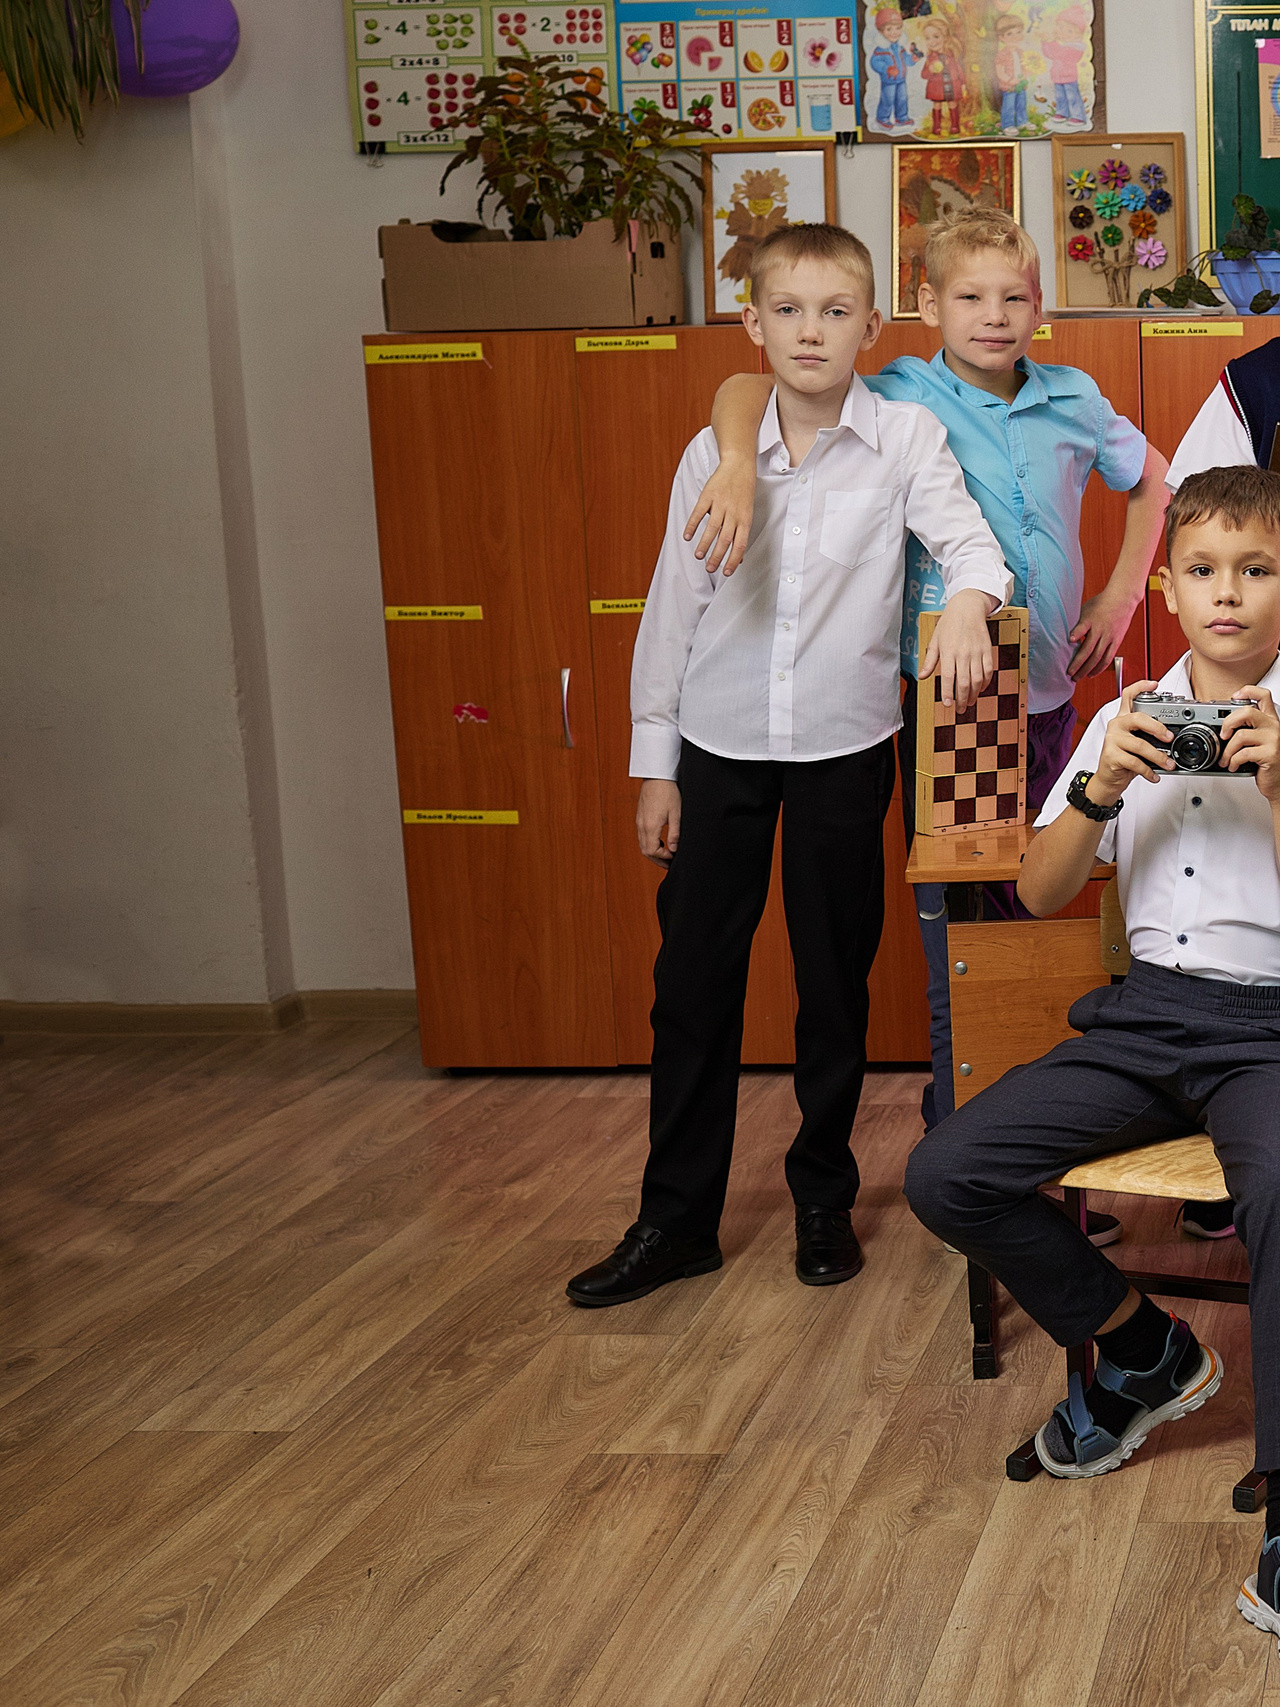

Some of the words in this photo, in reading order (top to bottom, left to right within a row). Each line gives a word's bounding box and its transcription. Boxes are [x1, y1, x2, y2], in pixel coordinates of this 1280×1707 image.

[394, 21, 408, 35] 4
[540, 17, 550, 31] 2
[1230, 18, 1269, 31] ПЛАН
[662, 36, 674, 46] 10
[397, 91, 410, 105] 4
[1152, 327, 1185, 335] Кожина
[441, 350, 477, 359] Матвей
